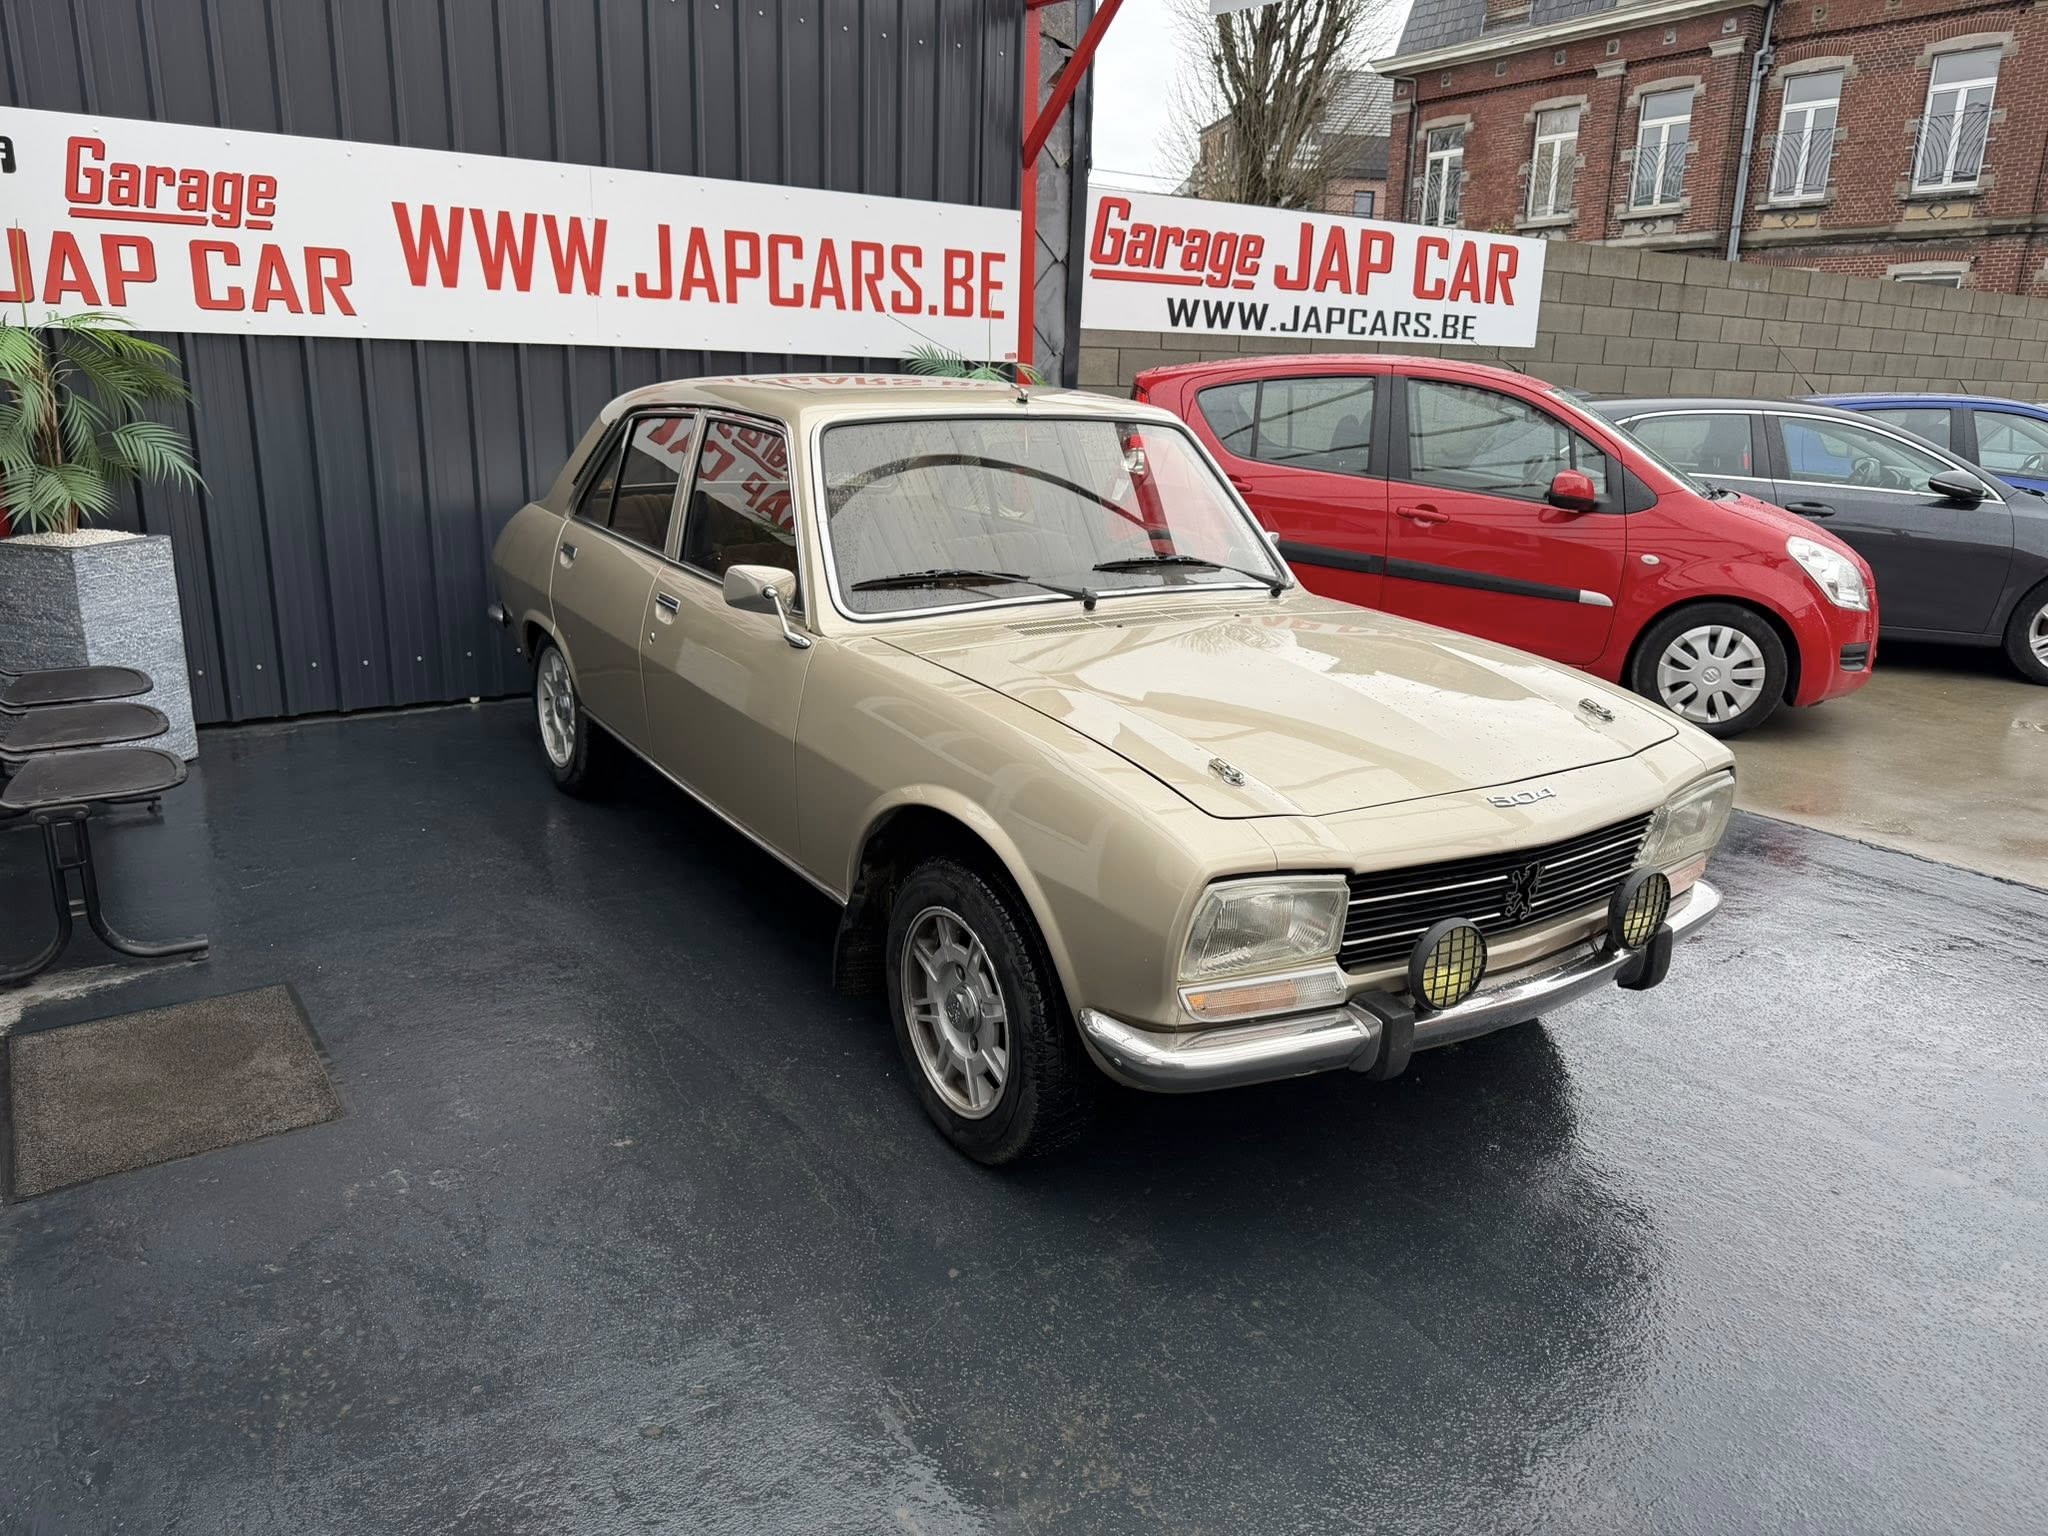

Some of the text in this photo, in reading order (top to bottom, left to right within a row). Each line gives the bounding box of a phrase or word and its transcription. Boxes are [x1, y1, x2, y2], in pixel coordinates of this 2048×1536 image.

[65, 136, 278, 229] Garage
[189, 239, 357, 316] CAR
[391, 202, 1006, 320] WWW.JAPCARS.BE
[1090, 196, 1519, 306] Garage JAP CAR
[1166, 297, 1478, 341] WWW.JAPCARS.BE
[1486, 786, 1557, 808] 504
